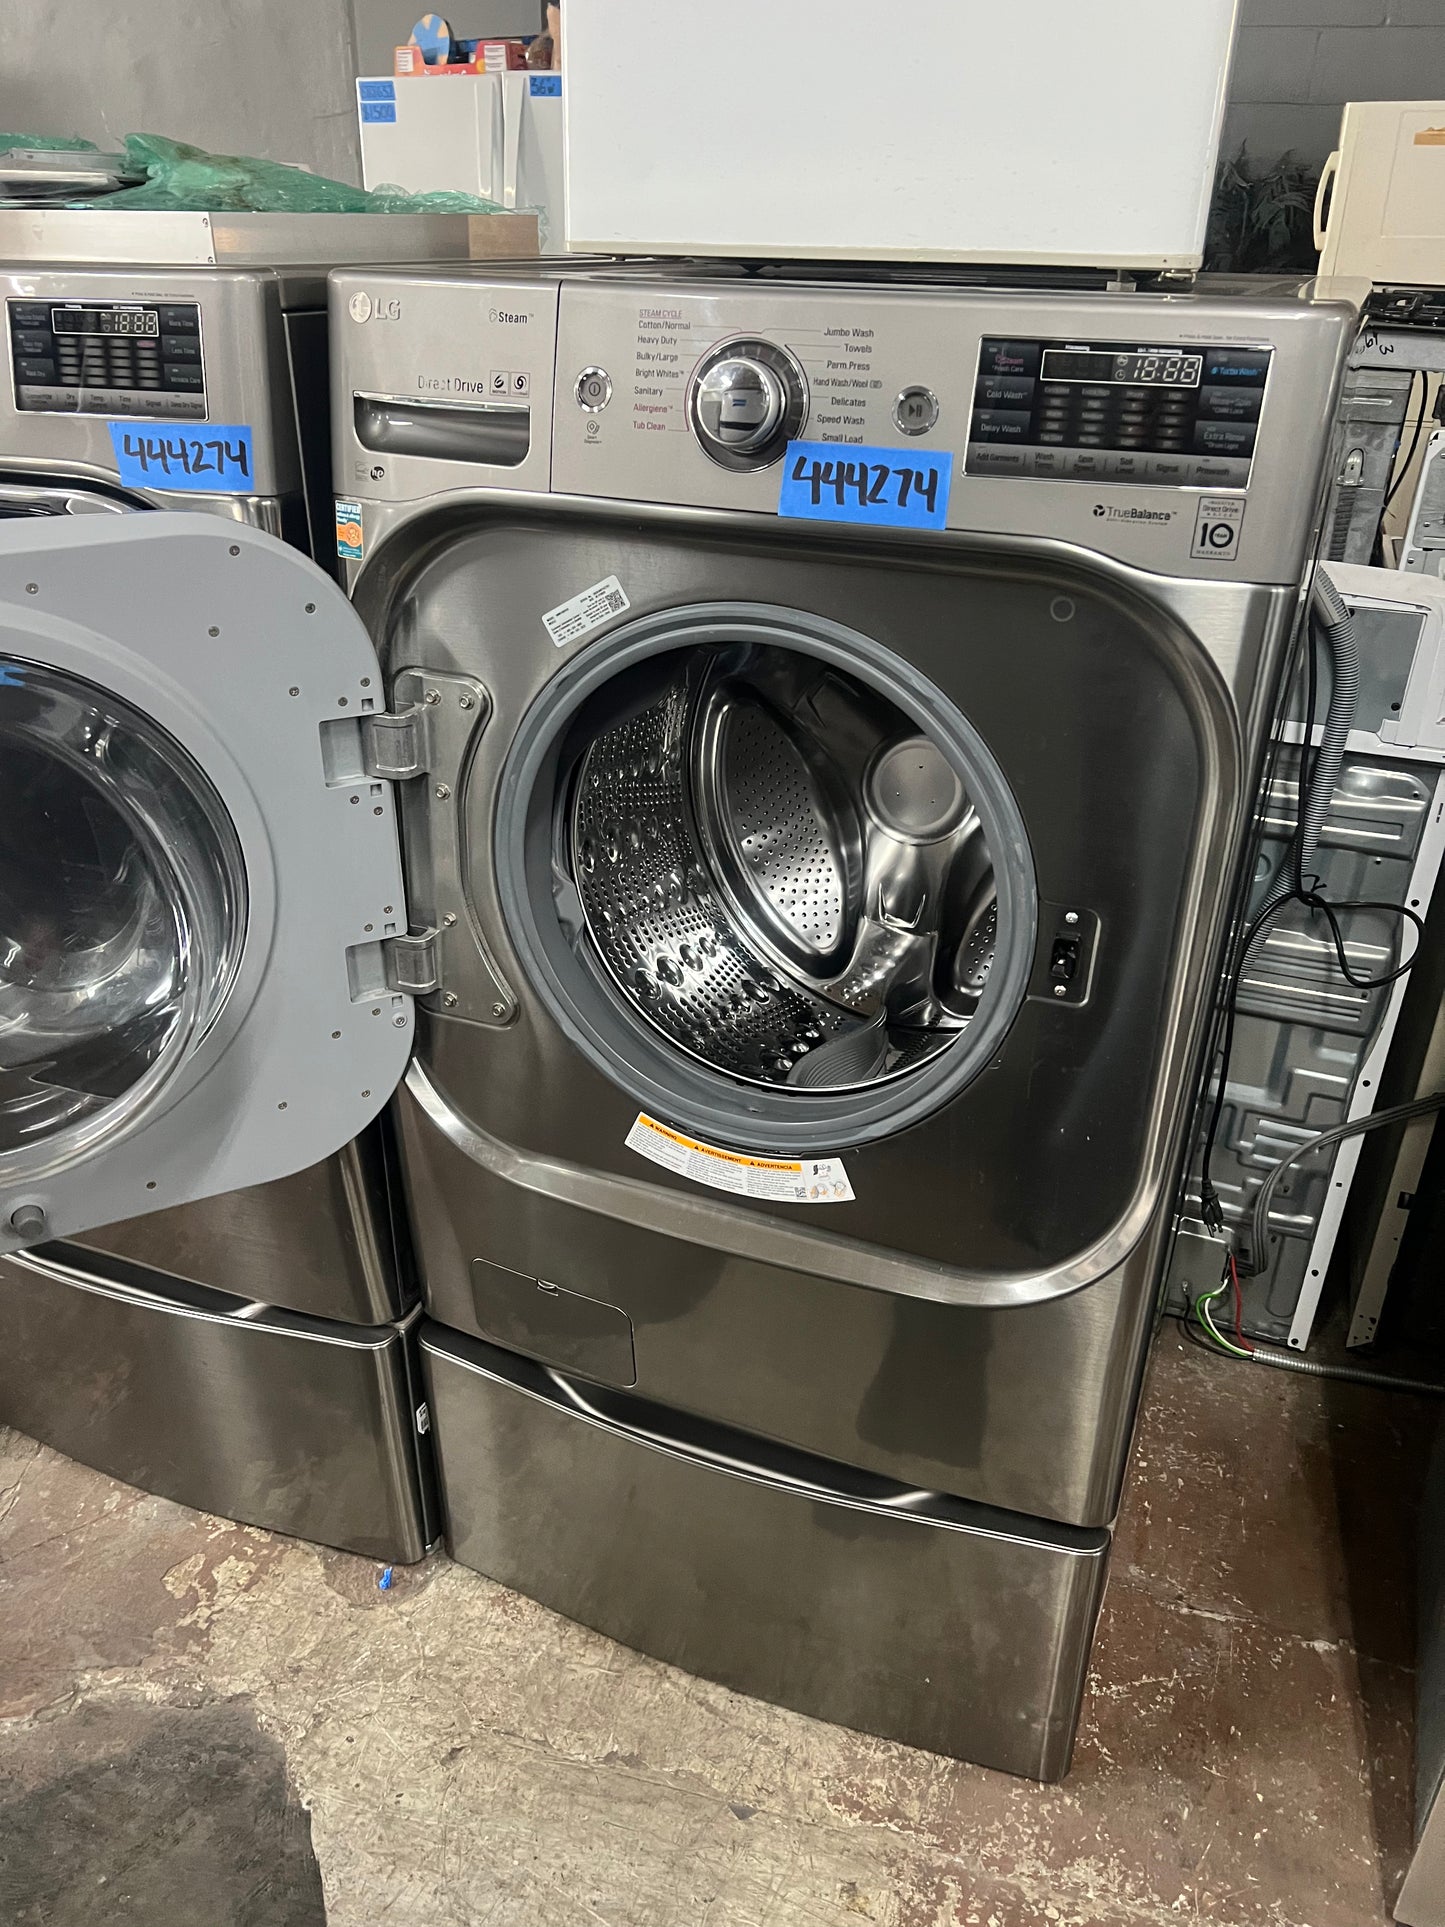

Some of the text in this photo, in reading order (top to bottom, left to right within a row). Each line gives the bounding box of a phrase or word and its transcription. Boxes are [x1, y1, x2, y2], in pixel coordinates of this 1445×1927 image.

[375, 298, 401, 320] LG
[640, 309, 682, 319] STEAM CYCLE
[638, 320, 690, 330] Cotton/Normal
[824, 327, 874, 338] Jumbo Wash
[637, 335, 678, 346] Heavy Duty
[844, 343, 872, 353] Towels
[636, 351, 679, 363] Bulky/Large
[827, 359, 870, 371] Perm Press
[635, 368, 655, 379] Bright
[454, 377, 484, 394] Drive
[813, 376, 869, 388] Hand Wash/Wool
[634, 385, 663, 397] Sanitary
[986, 389, 1002, 399] Cold
[831, 396, 866, 407] Delicates
[816, 413, 865, 425] Speed Wash
[633, 420, 666, 431] Tub Clean
[980, 423, 1021, 433] Delay Wash
[822, 432, 863, 444] Small Load
[124, 434, 249, 477] 444274
[792, 455, 939, 513] 444274
[1200, 522, 1234, 549] 10
[655, 1126, 677, 1141] WARNING
[701, 1148, 742, 1163] AVERTISSEMENT
[756, 1162, 793, 1171] ADVERTENCIA
